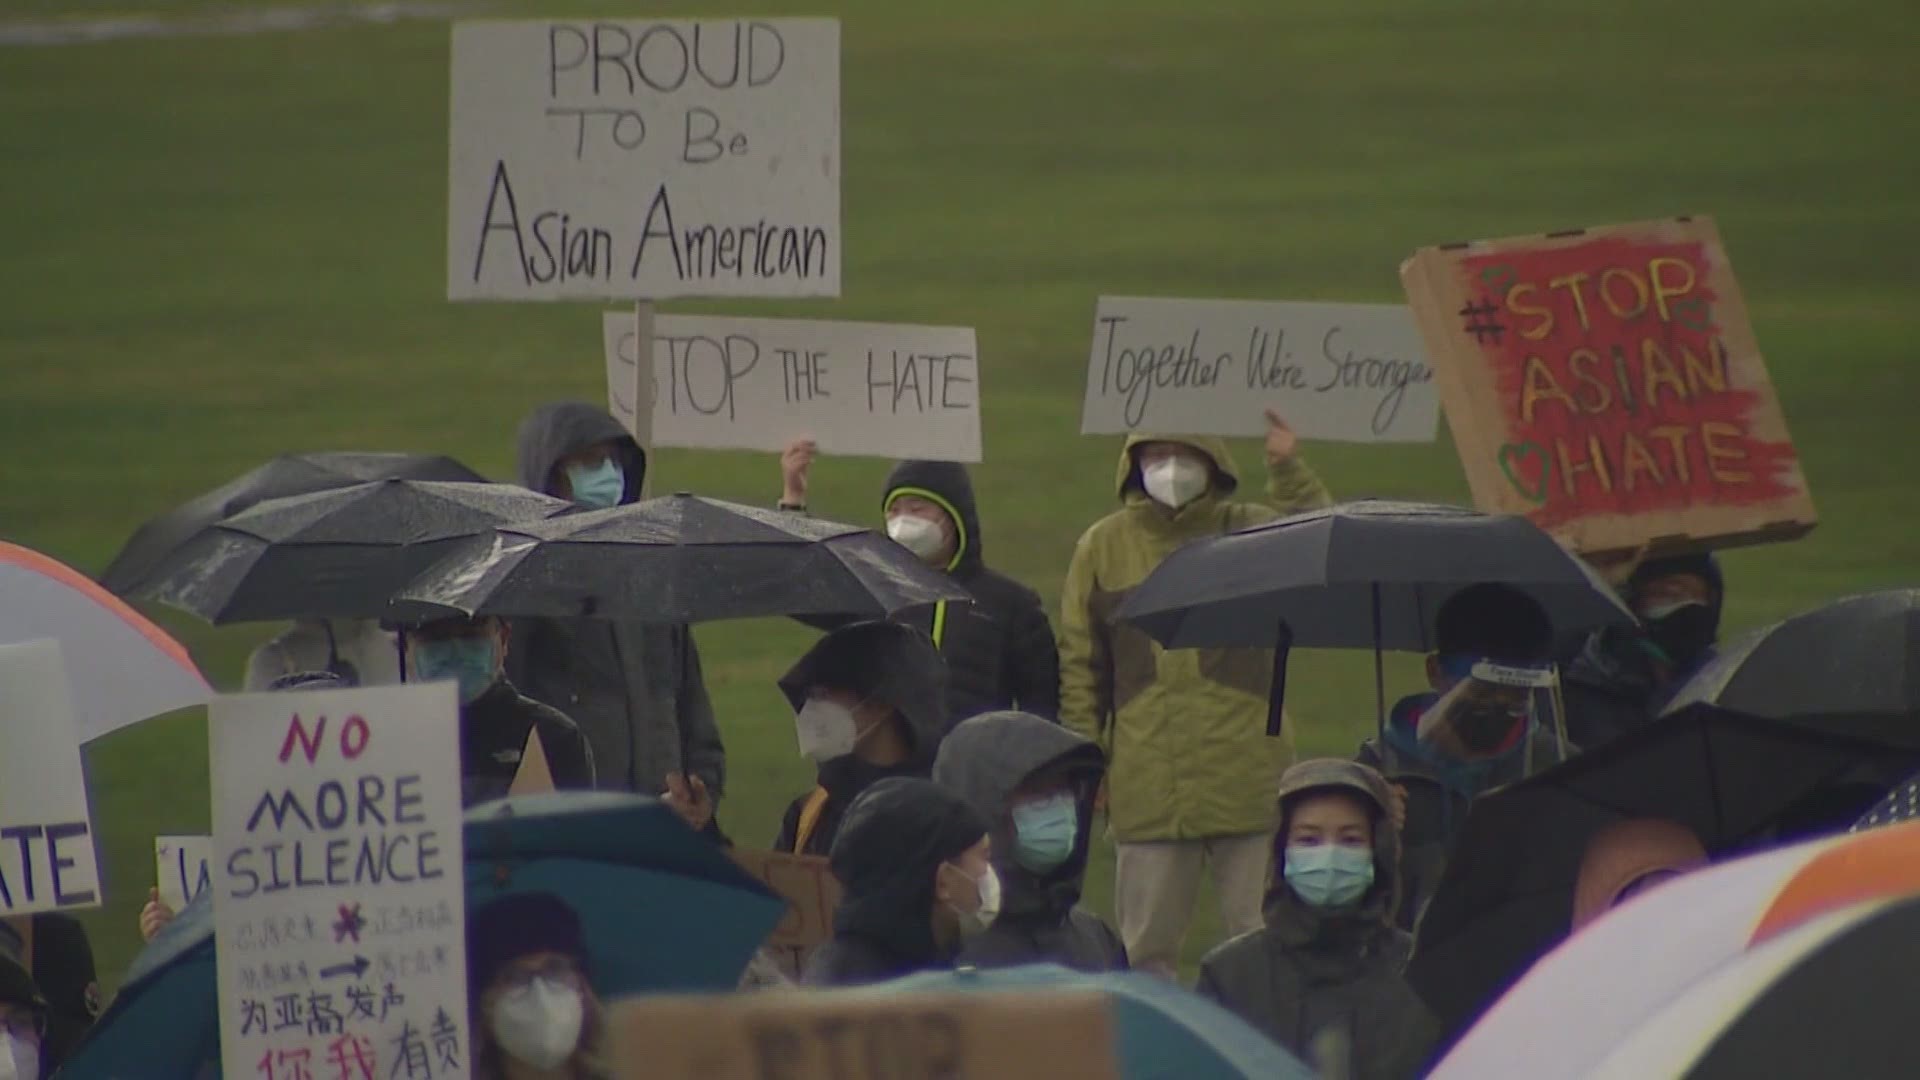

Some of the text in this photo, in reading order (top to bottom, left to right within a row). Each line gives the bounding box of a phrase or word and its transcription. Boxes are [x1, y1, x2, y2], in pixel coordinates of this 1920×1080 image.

[550, 23, 785, 98] PROUD
[545, 106, 749, 164] TO Be
[474, 159, 828, 287] Asian American
[774, 348, 831, 404] THE
[867, 348, 973, 415] HATE
[1100, 316, 1232, 428] Together
[1521, 336, 1730, 423] ASIAN
[1554, 421, 1754, 497] HATE
[278, 712, 370, 766] NO
[246, 774, 426, 833] MORE
[227, 831, 444, 898] SILENCE
